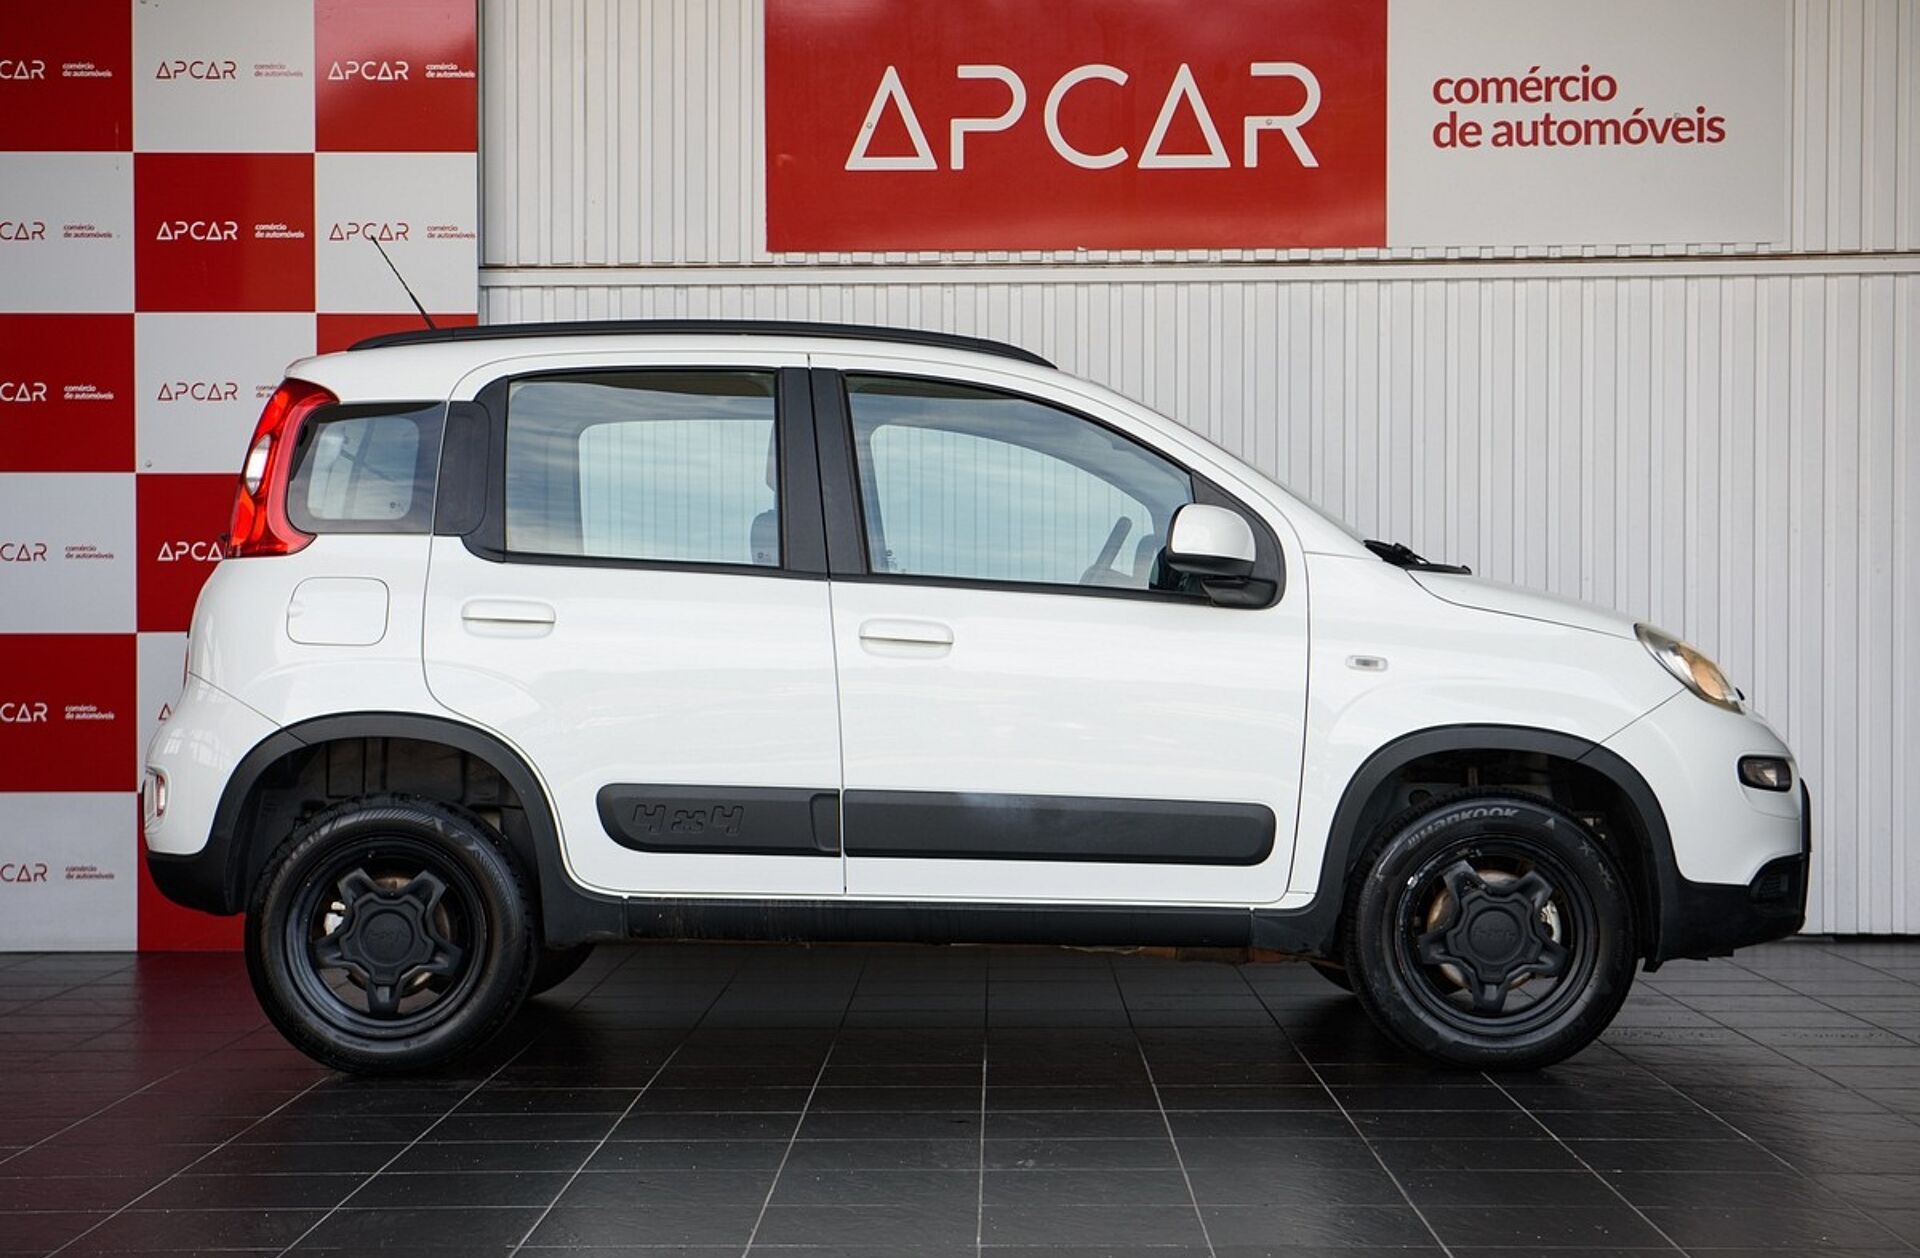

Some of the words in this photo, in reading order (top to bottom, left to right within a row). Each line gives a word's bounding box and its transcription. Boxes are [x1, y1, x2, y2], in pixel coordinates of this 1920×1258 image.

[156, 61, 237, 80] APCAR
[328, 60, 409, 80] APCAR
[1432, 64, 1618, 104] comércio
[845, 62, 1322, 170] APCAR
[1432, 111, 1482, 148] de
[1490, 106, 1726, 147] automóveis
[156, 221, 238, 240] APCAR
[329, 222, 409, 241] APCAR
[157, 382, 238, 401] APCAR
[157, 541, 223, 561] APCA
